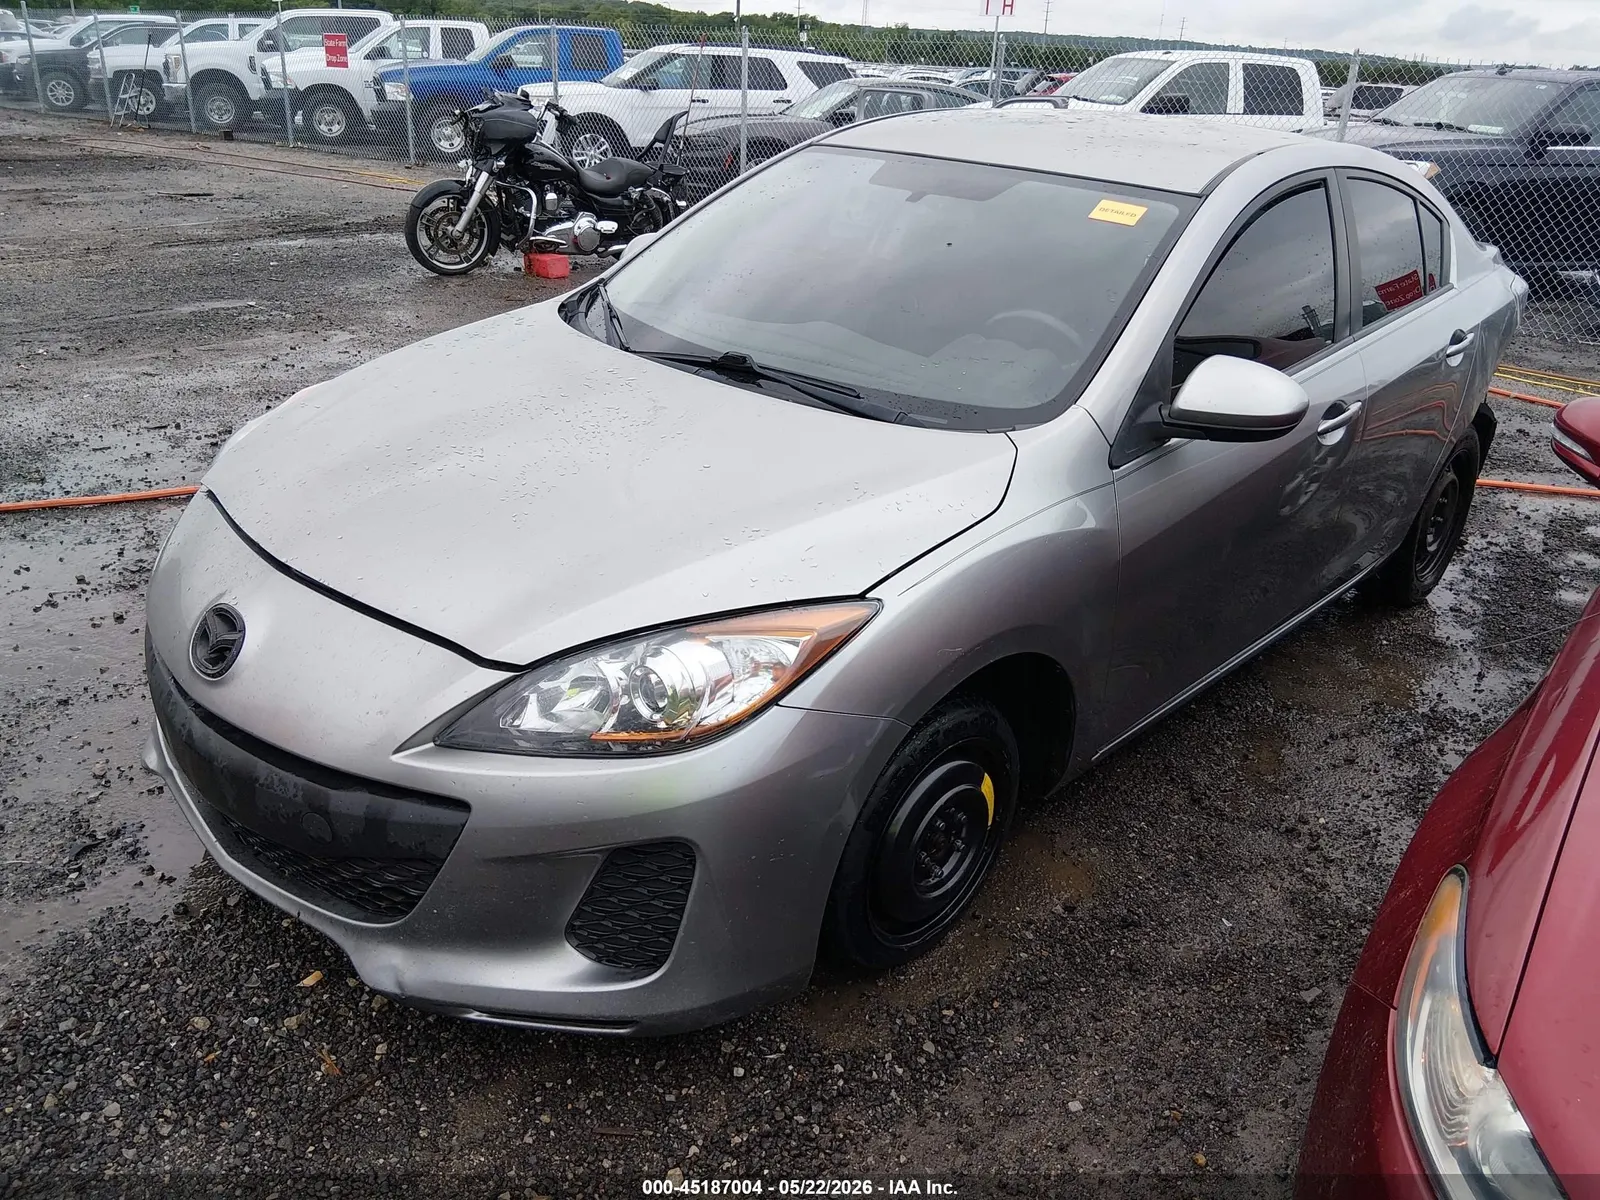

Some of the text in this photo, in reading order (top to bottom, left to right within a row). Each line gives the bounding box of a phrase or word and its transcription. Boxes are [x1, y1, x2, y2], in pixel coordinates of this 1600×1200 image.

[324, 38, 346, 47] State Farm
[326, 53, 347, 63] Drop Zone
[1099, 207, 1137, 218] DETAILED
